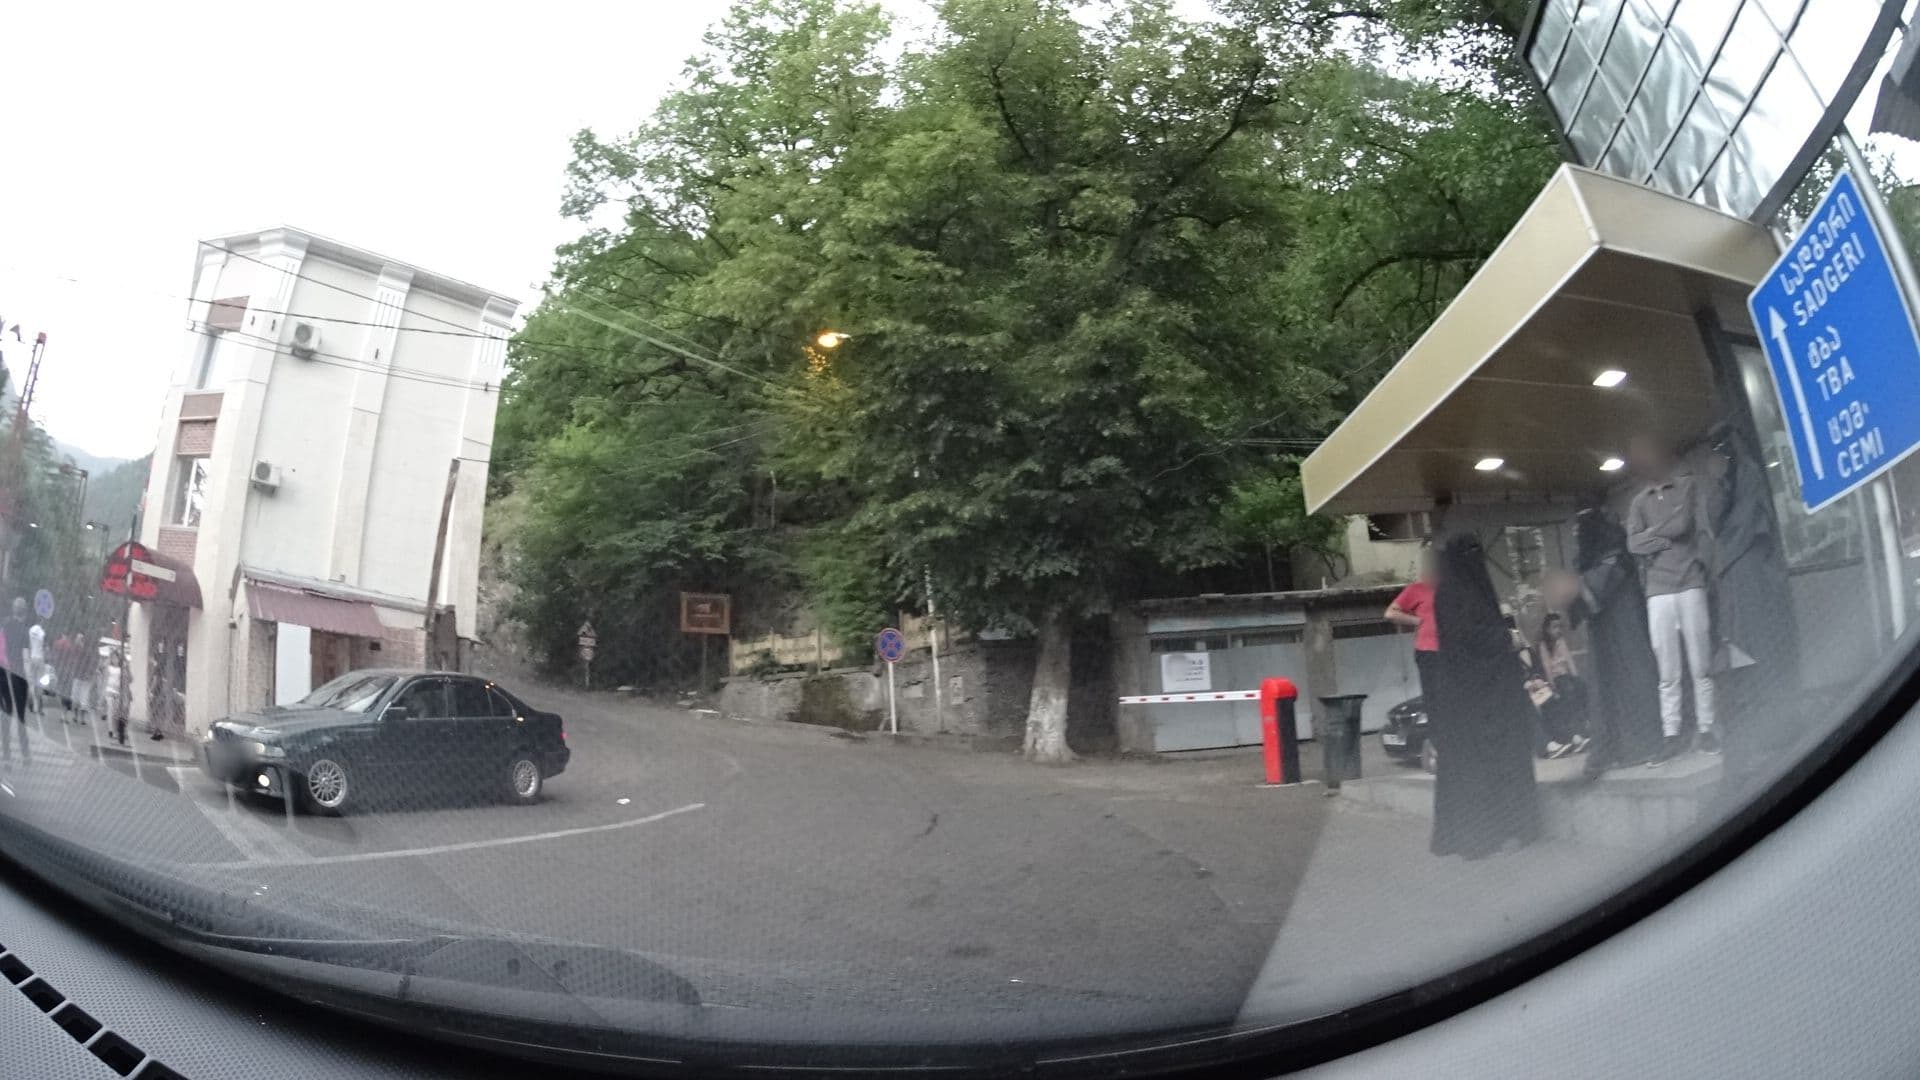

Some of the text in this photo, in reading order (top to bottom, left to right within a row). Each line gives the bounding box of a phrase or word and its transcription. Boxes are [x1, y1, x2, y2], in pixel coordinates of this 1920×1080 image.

[1779, 191, 1857, 296] სადგერი
[1792, 232, 1866, 327] SADGERI
[1807, 325, 1842, 369] ტბა
[1816, 356, 1856, 401] TBA
[1837, 426, 1885, 478] CEMI
